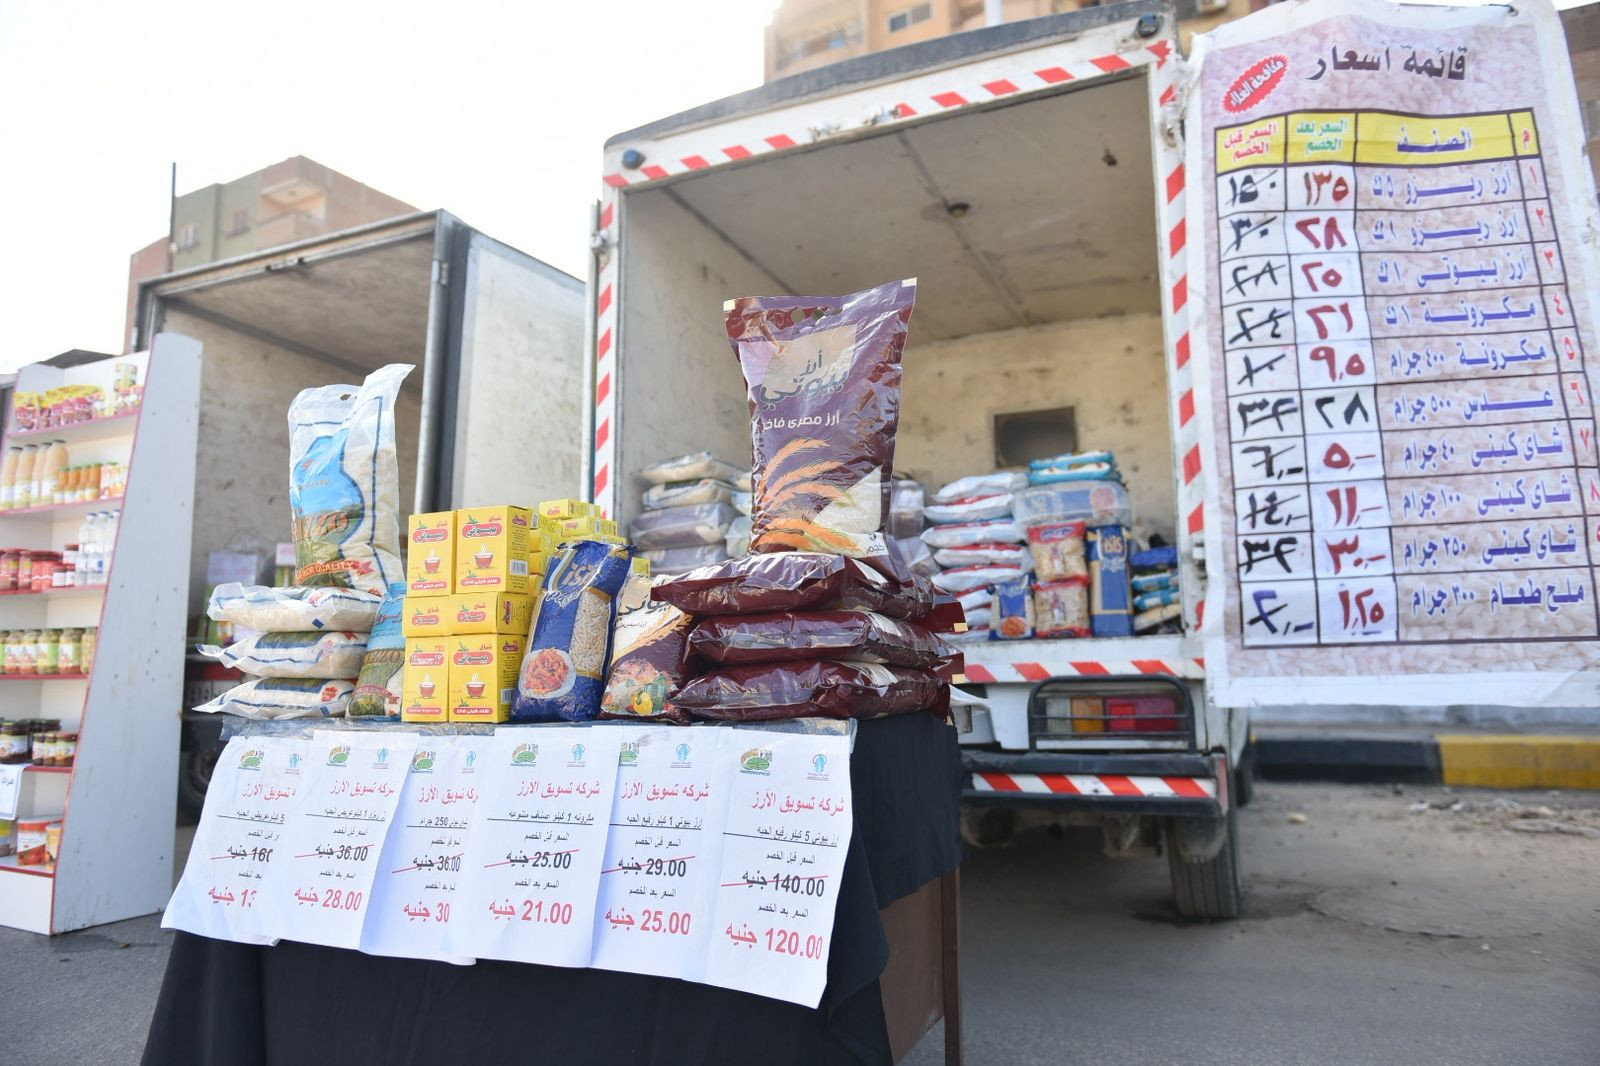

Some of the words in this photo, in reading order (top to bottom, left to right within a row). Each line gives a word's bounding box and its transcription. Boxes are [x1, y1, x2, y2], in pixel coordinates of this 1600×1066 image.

[1306, 41, 1390, 80] أسعار
[1400, 44, 1468, 80] قائمة
[1246, 122, 1277, 140] السعر
[1296, 120, 1314, 135] بعد
[1314, 119, 1348, 136] السعر
[1224, 130, 1244, 149] قبل
[1305, 137, 1342, 154] الخصم
[1232, 143, 1270, 162] الخصم
[1303, 170, 1350, 206] ١٣٥
[1536, 207, 1546, 228] ٢
[1295, 216, 1347, 251] ٢٨
[1301, 261, 1343, 292] ٢٥
[1553, 293, 1565, 316] ٤
[1306, 302, 1354, 340] ٢١
[1426, 348, 1445, 368] ٤٠٠
[1564, 336, 1576, 360] ٥
[800, 349, 822, 376] أرز
[1390, 349, 1421, 376] جرام
[1315, 391, 1369, 429] ٢٨
[1394, 395, 1426, 423] جرام
[1431, 395, 1451, 413] ٥٠٠
[762, 417, 785, 431] فاخر
[825, 410, 840, 426] أرز
[1579, 427, 1590, 449] ٧
[1404, 441, 1438, 470] جرام
[1441, 439, 1455, 461] ٤٠
[1403, 488, 1437, 518] جرام
[1440, 487, 1461, 504] ١٠٠
[1404, 537, 1438, 568] جرام
[1442, 536, 1467, 558] ٢٥٠
[315, 561, 353, 575] QUALITY
[1413, 585, 1447, 616] جرام
[1490, 577, 1542, 614] طعام
[1546, 576, 1585, 613] ملح
[541, 782, 573, 798] تسويق
[647, 783, 679, 801] تسويق
[780, 795, 815, 813] تسويق
[435, 816, 448, 827] 250
[553, 810, 565, 822] كيلو
[656, 814, 667, 826] كيلو
[791, 828, 802, 841] كيلو
[805, 831, 810, 841] 5
[315, 843, 334, 860] جنيه
[336, 845, 369, 862] 36.00
[506, 850, 529, 867] جنيه
[532, 851, 571, 869] 25.00
[413, 854, 435, 871] جنيه
[437, 855, 461, 872] 36.00
[618, 856, 642, 876] جنيه
[646, 858, 686, 877] 29.00
[743, 870, 768, 890] جنيه
[773, 873, 825, 897] 140.00
[208, 884, 235, 906] جنيه
[294, 886, 319, 907] جنيه
[322, 887, 363, 911] 28.00
[403, 901, 431, 922] جنيه
[488, 898, 516, 921] جنيه
[521, 898, 572, 925] 21.00
[605, 906, 634, 931] جنيه
[640, 909, 691, 936] 25.00
[726, 923, 757, 949] جنيه
[766, 928, 823, 960] 120.00
